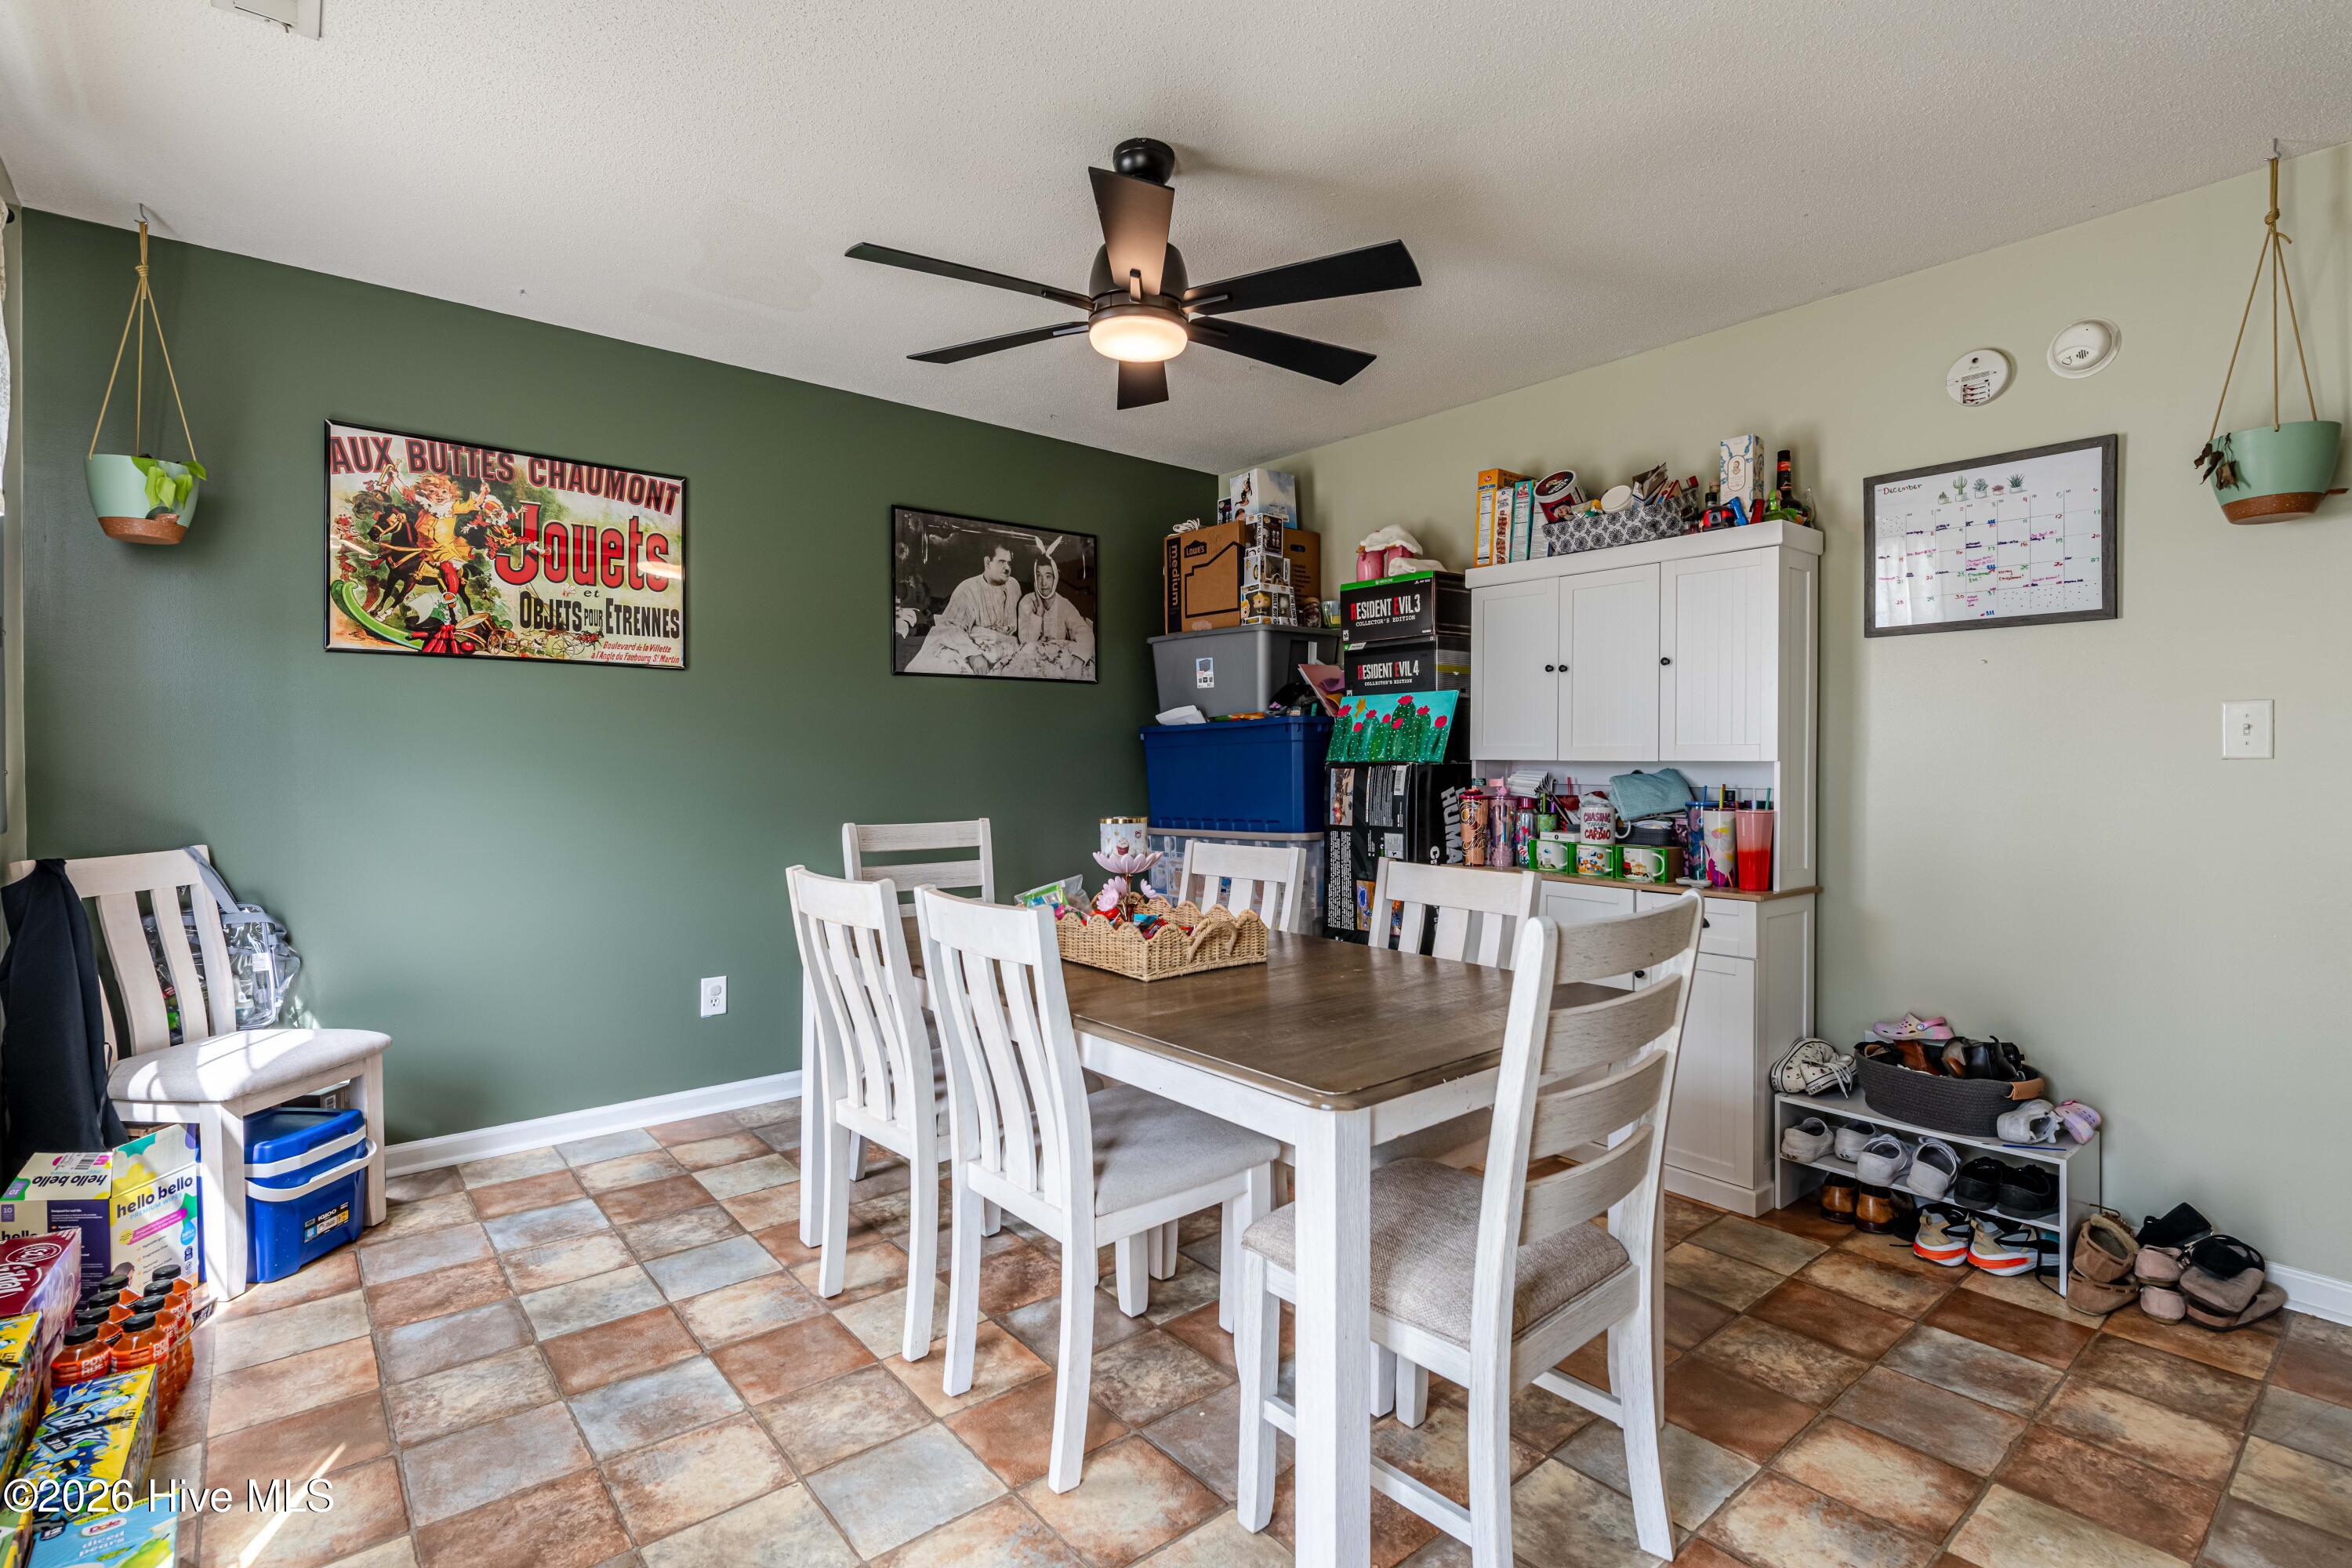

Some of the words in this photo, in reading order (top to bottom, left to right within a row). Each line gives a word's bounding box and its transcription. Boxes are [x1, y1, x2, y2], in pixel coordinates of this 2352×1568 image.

[330, 437, 392, 474] AUX
[405, 439, 515, 483] BUTTES
[528, 457, 681, 515] CHAUMONT
[1883, 483, 1922, 495] December
[495, 500, 669, 592] Jouets
[1186, 545, 1205, 556] LOWE'S
[1171, 545, 1180, 606] medium
[520, 591, 582, 632] OBJETS
[584, 608, 603, 626] POUR
[605, 598, 680, 639] ETRENNES
[1351, 598, 1392, 621] RESIDENT
[1393, 594, 1414, 615] EVIL
[1414, 593, 1421, 614] 3
[1356, 617, 1389, 626] COLLECTOR'S
[603, 641, 636, 652] Boulevard
[648, 644, 672, 652] Villette
[625, 653, 652, 663] Faubourg
[1357, 662, 1392, 681] RESIDENT
[1395, 661, 1413, 677] EVIL
[1414, 660, 1419, 676] 4
[1441, 786, 1463, 863] HUMA
[1584, 812, 1610, 822] CHASING
[1584, 829, 1610, 840] CARDIO
[32, 1176, 71, 1187] bello
[71, 1175, 107, 1186] hello
[117, 1193, 154, 1218] hello
[158, 1177, 193, 1200] bello
[130, 1203, 162, 1219] PREMIUM
[162, 1193, 182, 1205] WIPES
[318, 1209, 336, 1221] IGLOO
[89, 1520, 121, 1534] Dole
[79, 1537, 125, 1557] pears
[82, 1530, 124, 1548] diced
